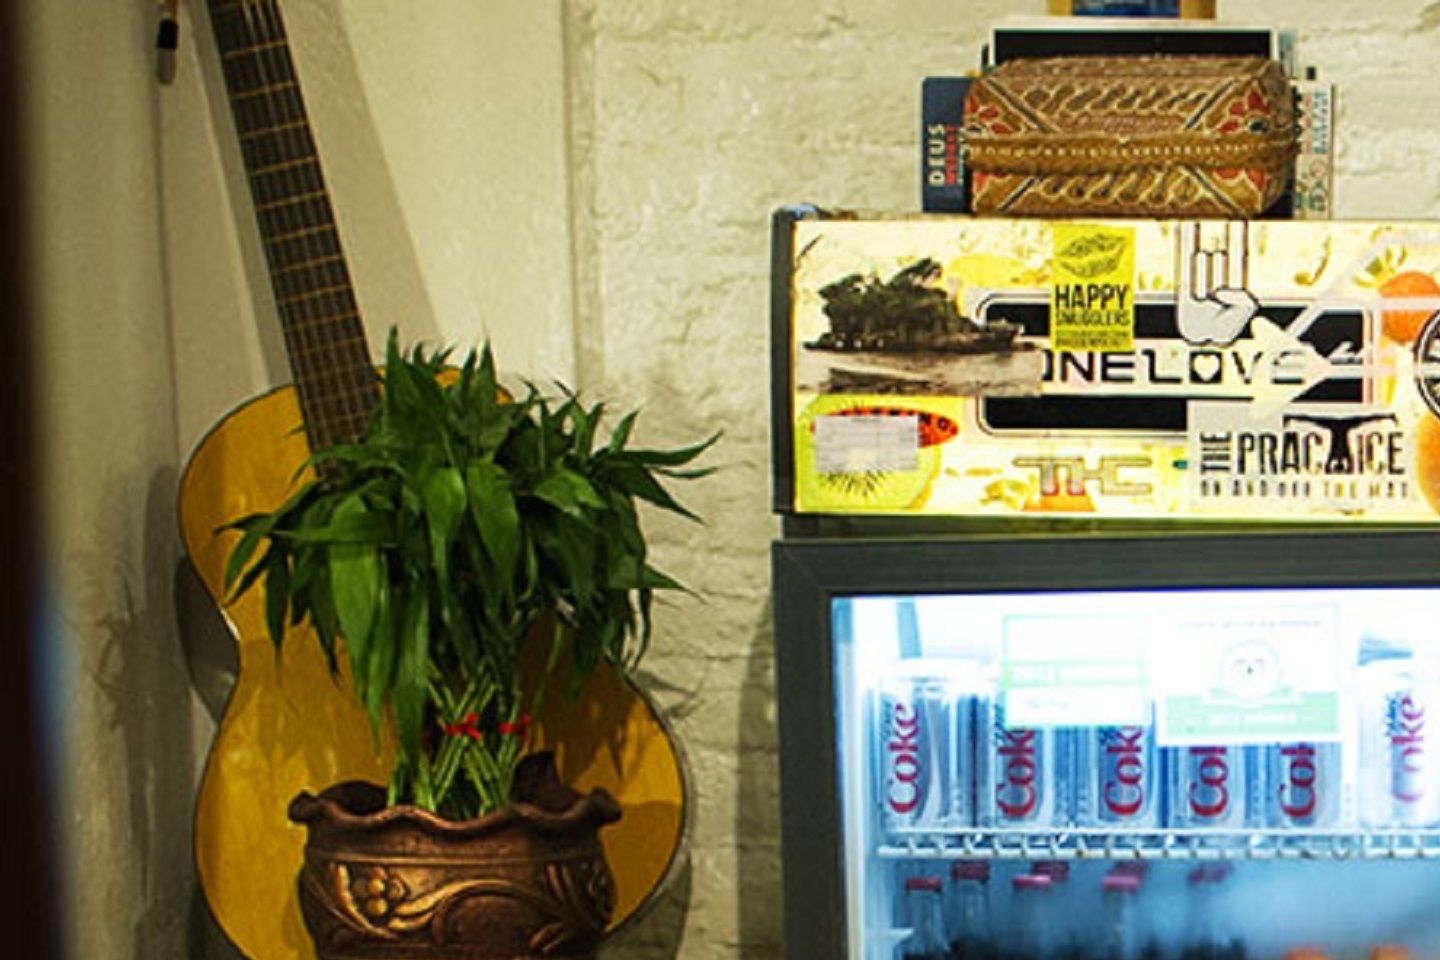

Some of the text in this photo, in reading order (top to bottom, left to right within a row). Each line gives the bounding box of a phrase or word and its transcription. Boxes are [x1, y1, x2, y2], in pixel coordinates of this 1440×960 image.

[1055, 283, 1129, 310] HAPPY
[887, 702, 920, 814] Coke
[996, 728, 1036, 818] Cok
[1104, 727, 1144, 816] Cok
[1188, 745, 1229, 817] Co
[1278, 743, 1317, 818] Co
